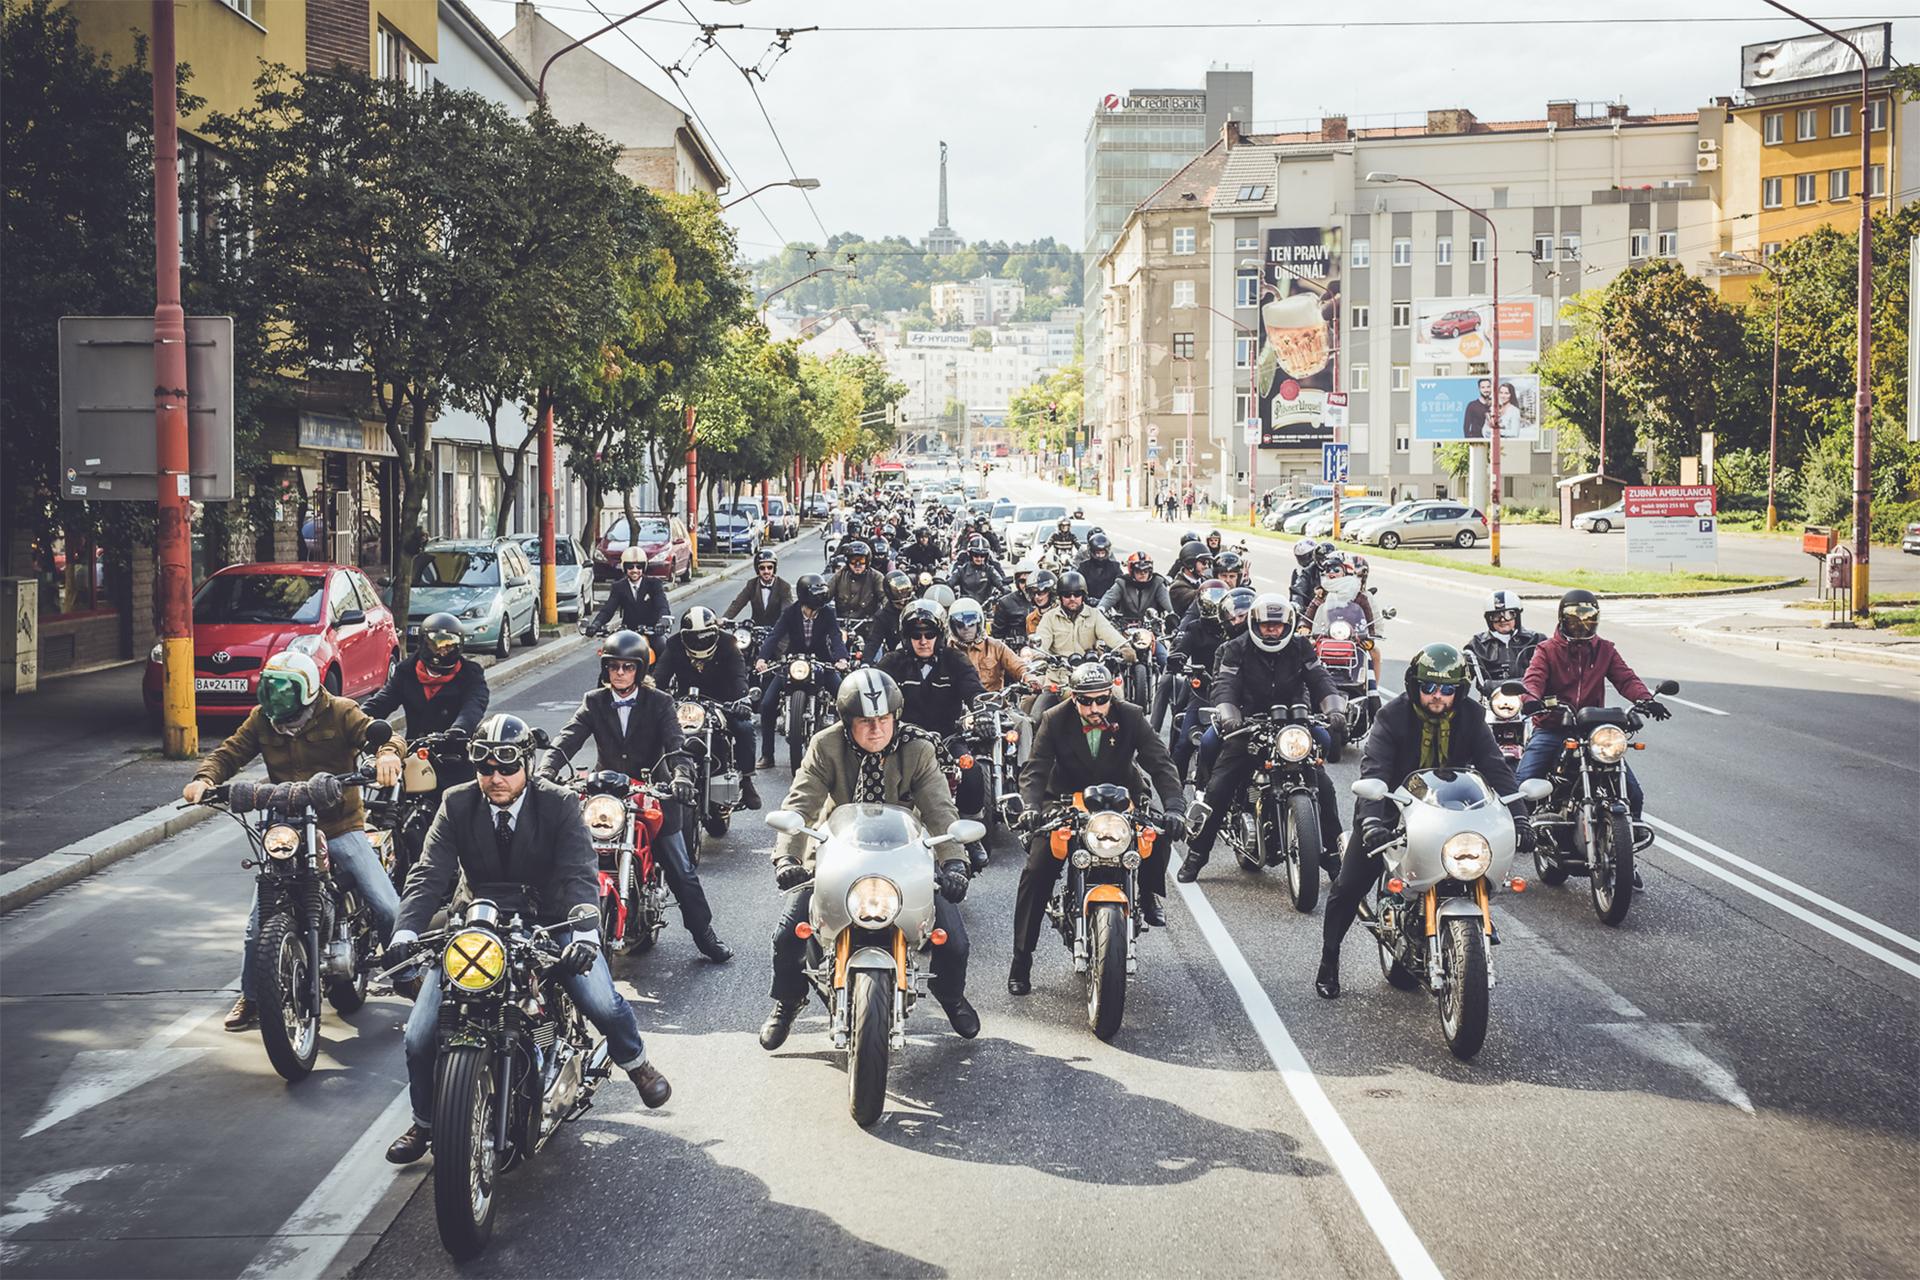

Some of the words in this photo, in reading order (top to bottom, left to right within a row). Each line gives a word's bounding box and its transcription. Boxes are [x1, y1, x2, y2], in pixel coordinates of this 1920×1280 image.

[1122, 96, 1169, 109] UniCredit
[1173, 96, 1200, 109] Bank
[1270, 246, 1291, 261] TEN
[928, 335, 968, 343] HYUNDAI
[1629, 488, 1657, 498] ZUBNÁ
[1659, 488, 1712, 498] AMBULANCIA
[1702, 521, 1710, 531] P
